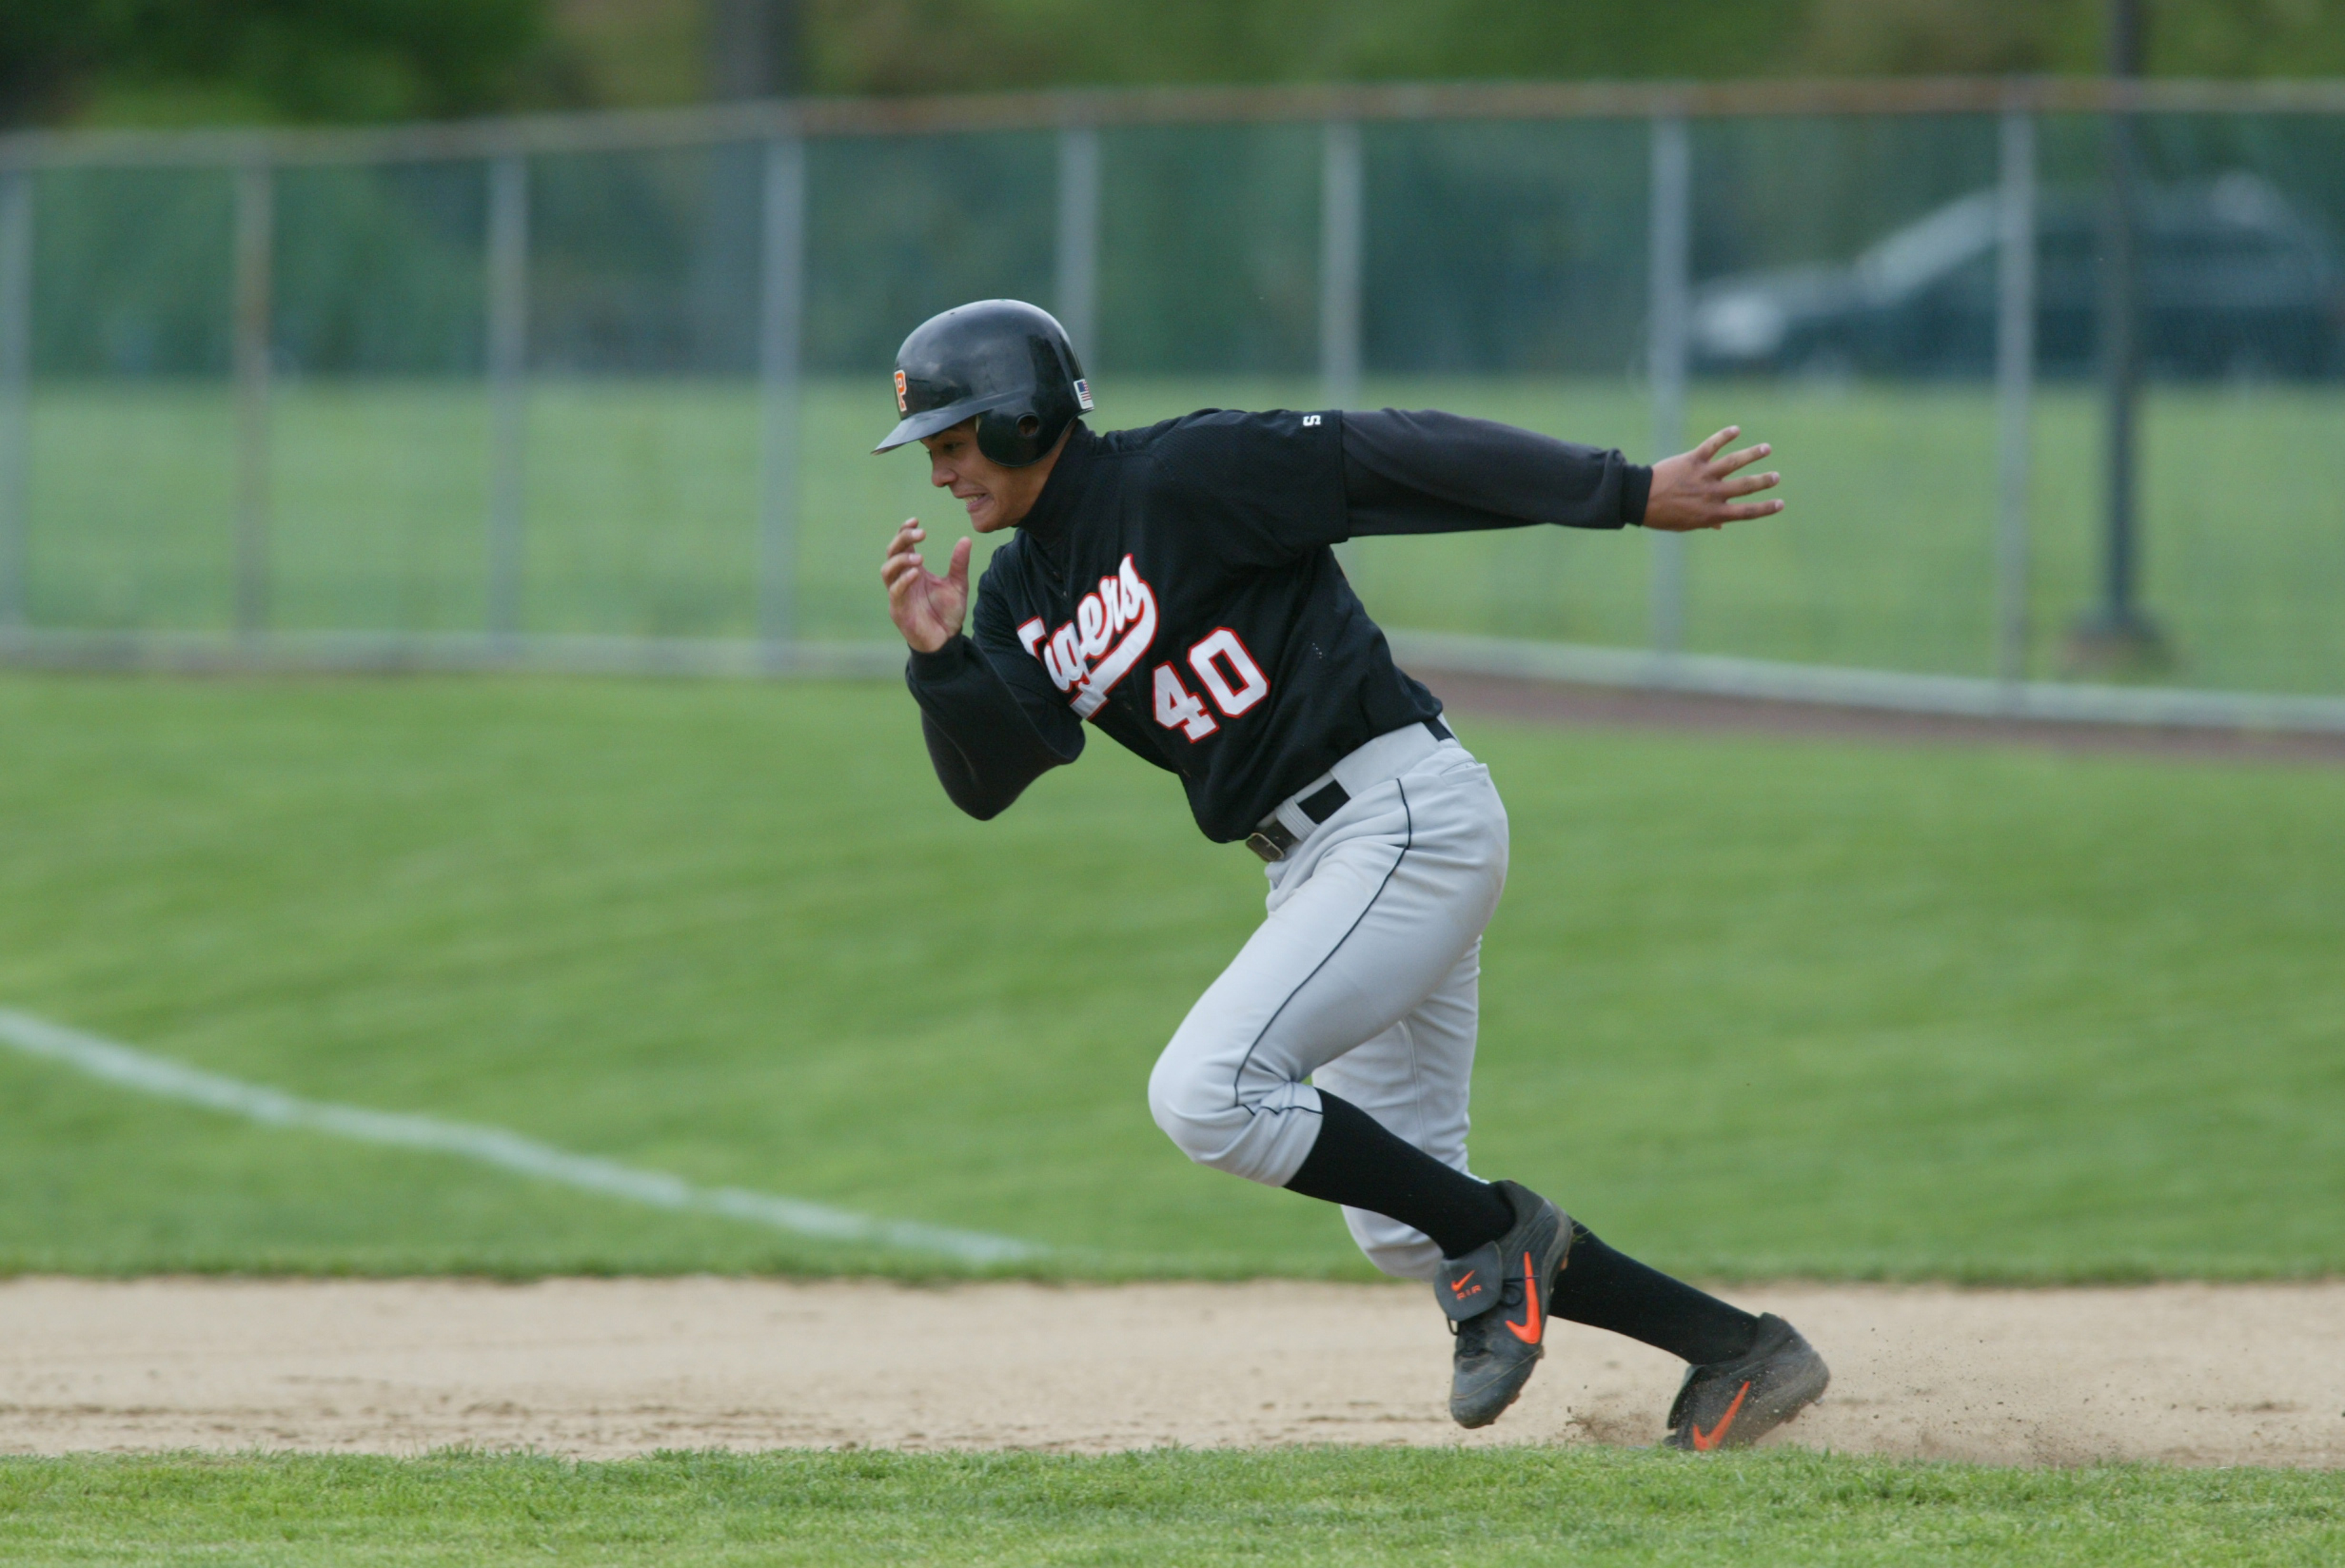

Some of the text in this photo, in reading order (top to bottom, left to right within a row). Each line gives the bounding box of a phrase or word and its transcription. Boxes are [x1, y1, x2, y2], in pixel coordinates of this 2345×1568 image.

[894, 369, 907, 412] P
[1152, 626, 1270, 743] 40
[1456, 1284, 1481, 1300] AIR
